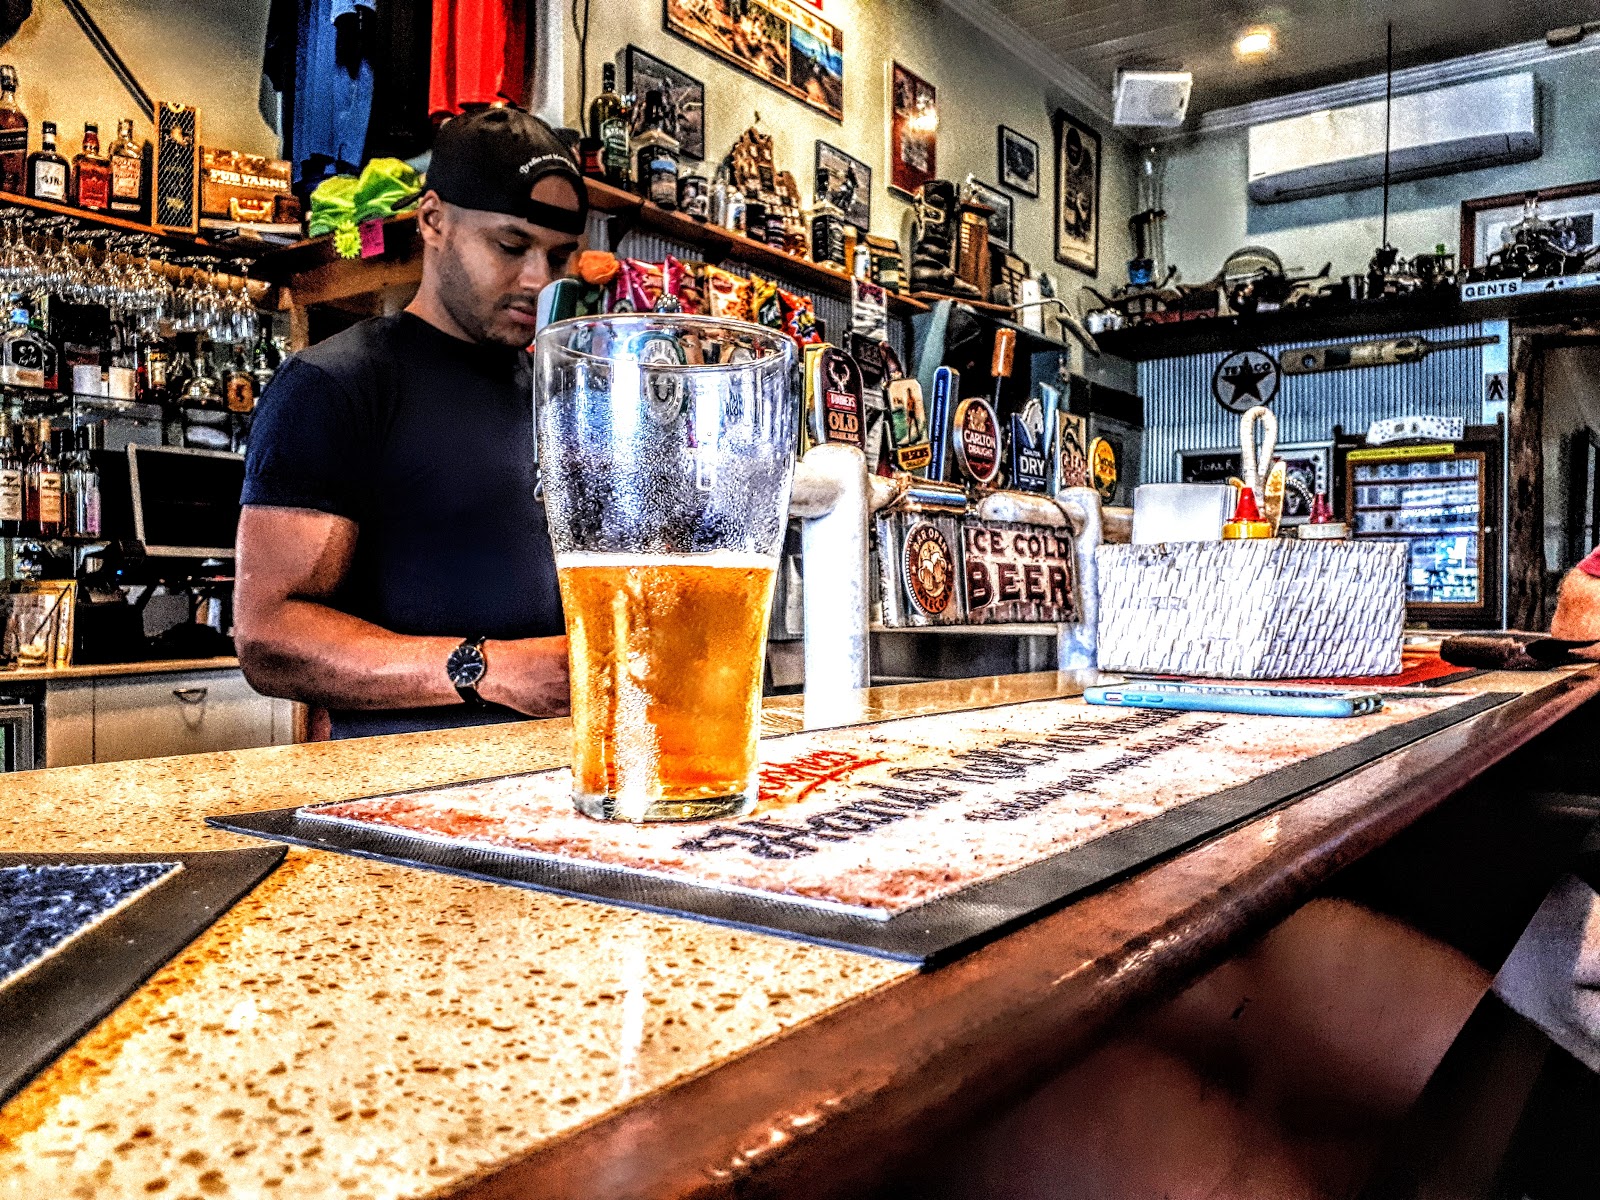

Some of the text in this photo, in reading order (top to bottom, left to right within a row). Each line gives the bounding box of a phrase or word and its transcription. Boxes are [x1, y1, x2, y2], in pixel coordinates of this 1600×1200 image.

[210, 168, 288, 189] PUB YARNS
[1465, 282, 1518, 298] GENTS
[828, 411, 859, 433] OLD
[963, 429, 996, 449] CARLTON
[1019, 455, 1045, 477] DRY
[912, 527, 948, 553] BAR OPEN
[964, 528, 1071, 558] ICE COLD
[966, 561, 1073, 610] BEER
[675, 782, 965, 860] Hand
[886, 747, 1059, 786] Roll
